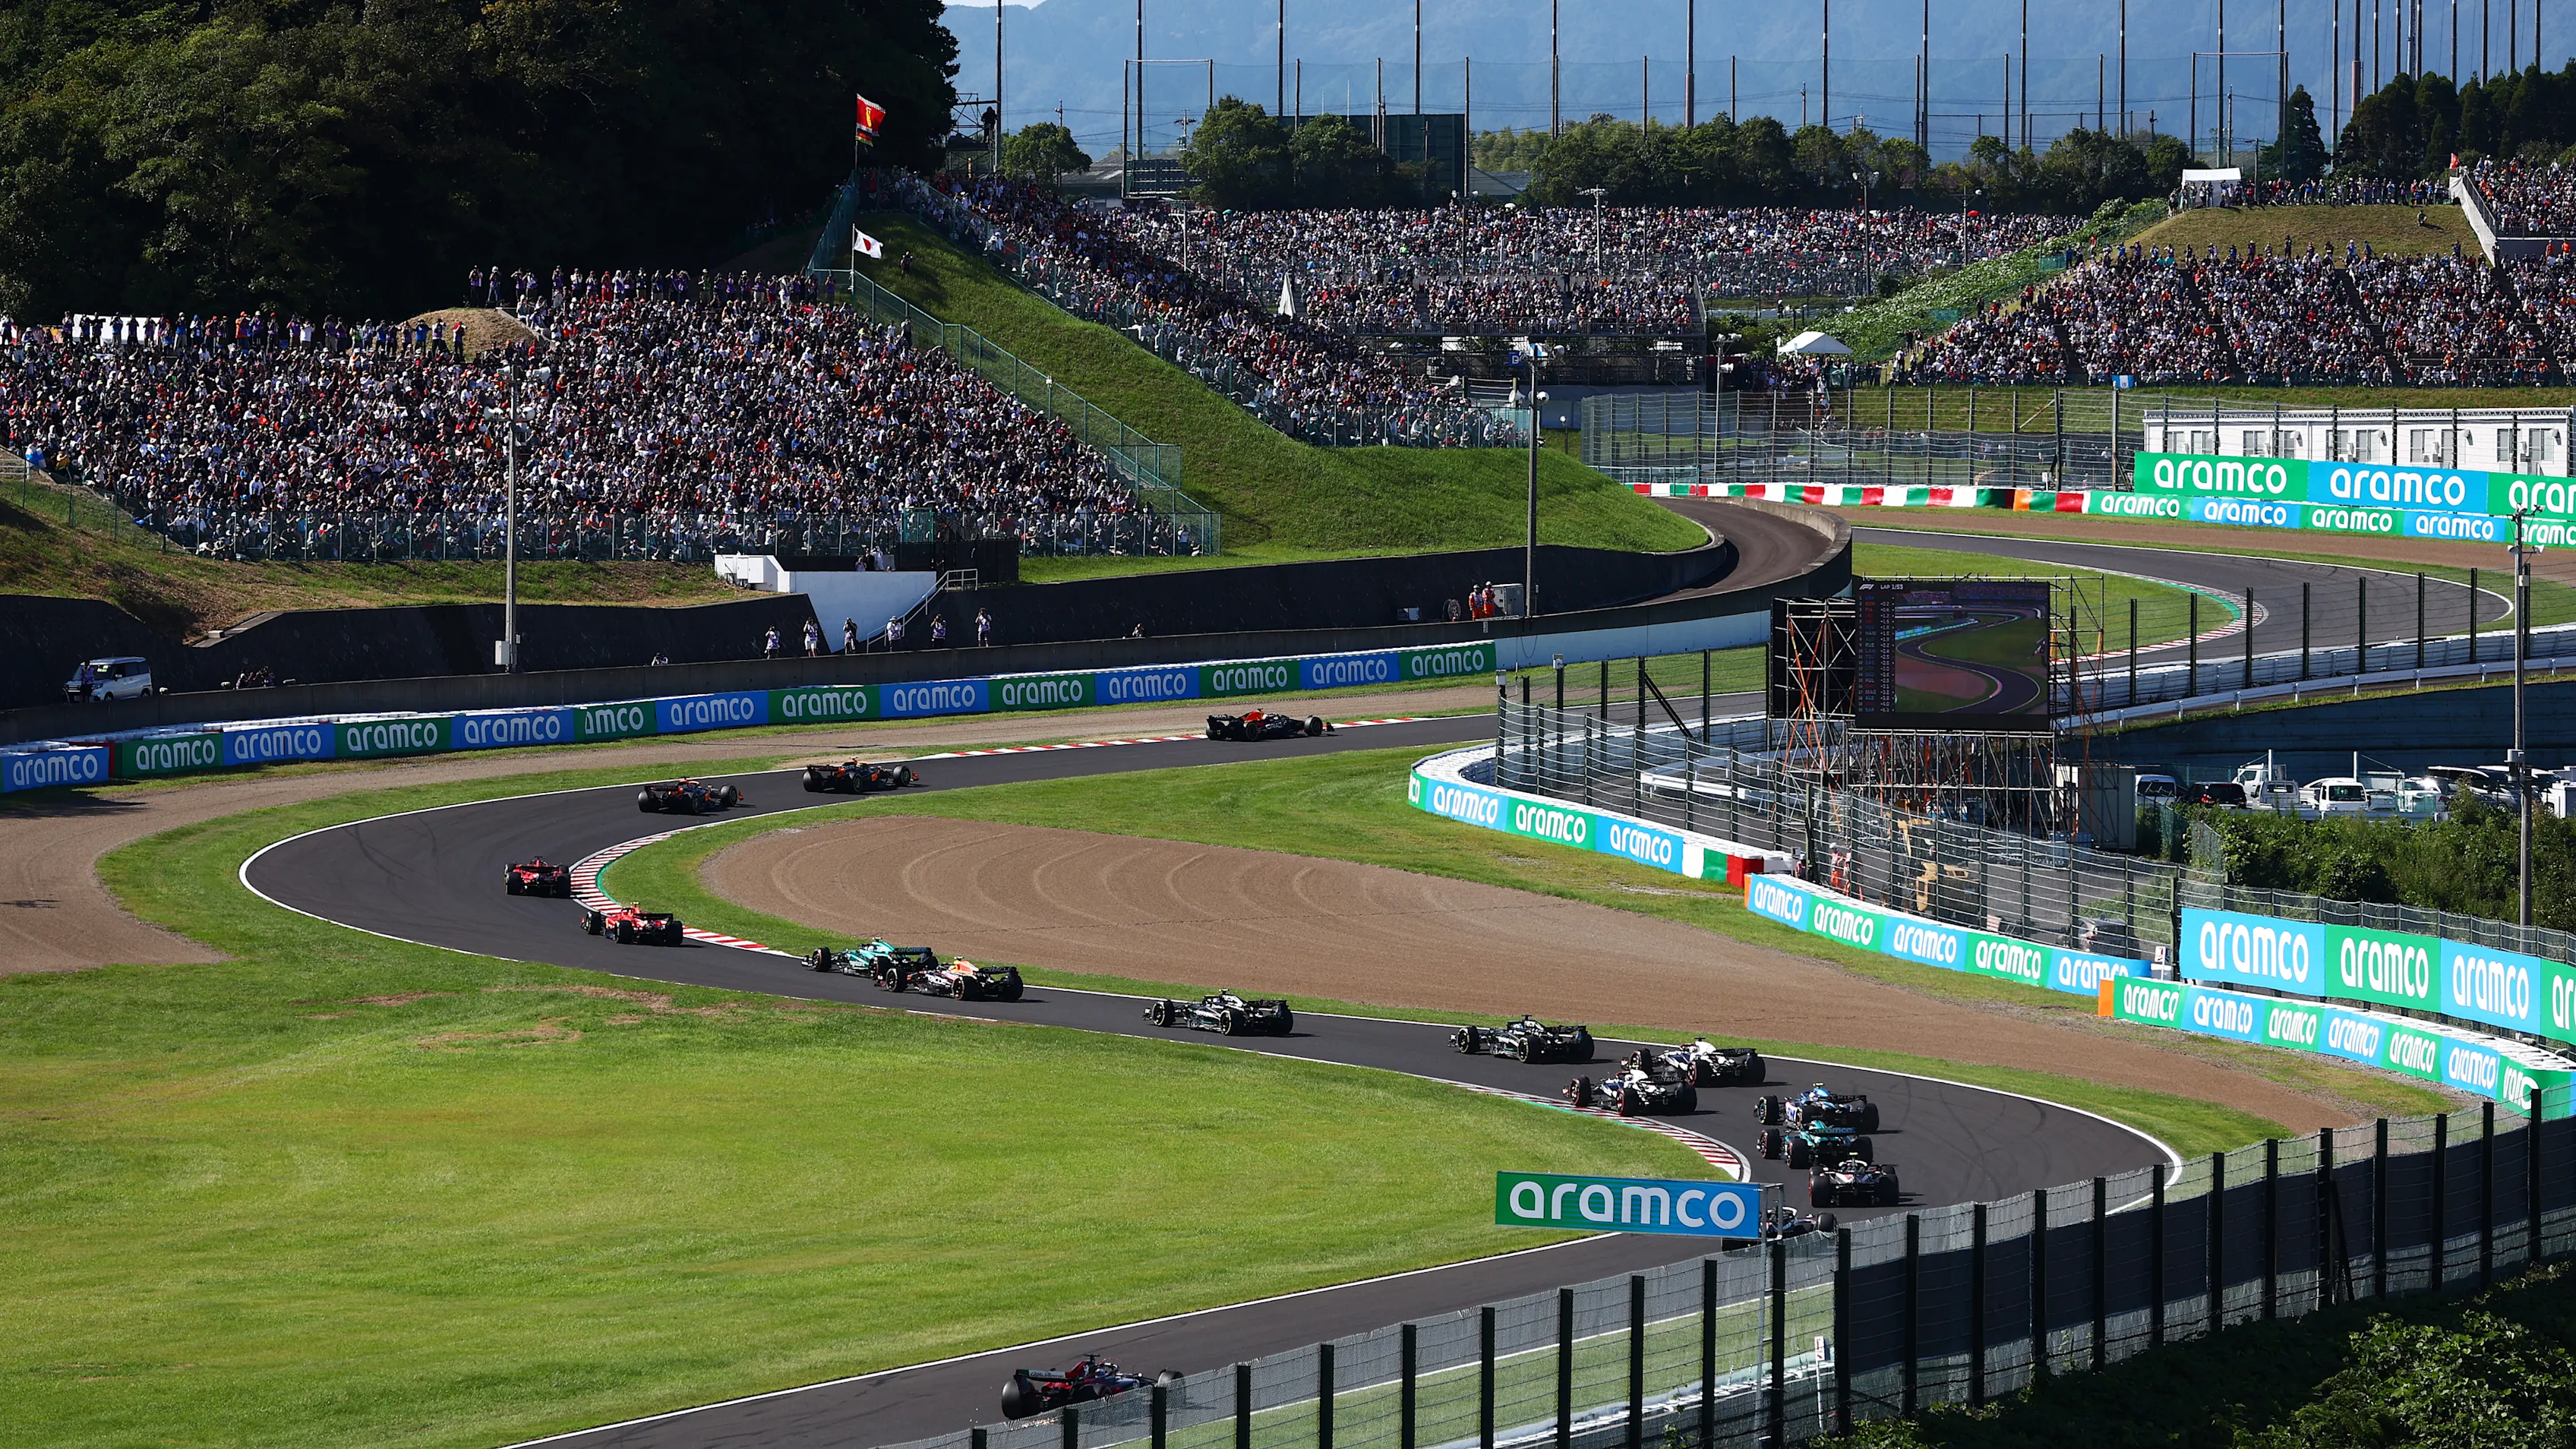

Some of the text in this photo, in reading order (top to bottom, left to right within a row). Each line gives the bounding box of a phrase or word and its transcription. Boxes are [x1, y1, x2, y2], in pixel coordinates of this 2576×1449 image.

[2155, 459, 2287, 494] aramco
[2330, 469, 2465, 506] aramco
[2101, 495, 2180, 516] aramco
[2204, 498, 2286, 525] aramco
[2509, 481, 2576, 514] ara
[2312, 510, 2392, 532] aramco
[2417, 514, 2493, 539] aramco
[1214, 666, 1287, 690] aramco
[1313, 659, 1387, 687] aramco
[1412, 650, 1484, 675] aramco
[781, 690, 867, 717] aramco
[894, 685, 975, 711] aramco
[1002, 680, 1082, 705] aramco
[1110, 674, 1185, 698] aramco
[465, 715, 560, 743] aramco
[671, 698, 753, 725] aramco
[235, 730, 320, 758] aramco
[347, 723, 437, 750] aramco
[14, 754, 97, 784] aramco
[136, 740, 215, 769] aramco
[1434, 786, 1498, 824] aramco
[1516, 804, 1586, 843] aramco
[1610, 825, 1672, 864] aramco
[1754, 882, 1802, 922] aramco
[1814, 904, 1874, 945] aramco
[1894, 924, 1956, 963] aramco
[1976, 940, 2041, 979] aramco
[2200, 919, 2310, 983] aramco
[2341, 938, 2429, 998] aramco
[2124, 984, 2180, 1021] aramco
[2453, 955, 2529, 1019] aramco
[2552, 975, 2576, 1030] ar
[2194, 996, 2252, 1036] aramco
[2269, 1009, 2316, 1044] aramco
[2328, 1018, 2379, 1057] aramco
[2390, 1032, 2436, 1073] aramco
[2448, 1047, 2496, 1091] aramco
[1510, 1181, 1744, 1229] aramco
